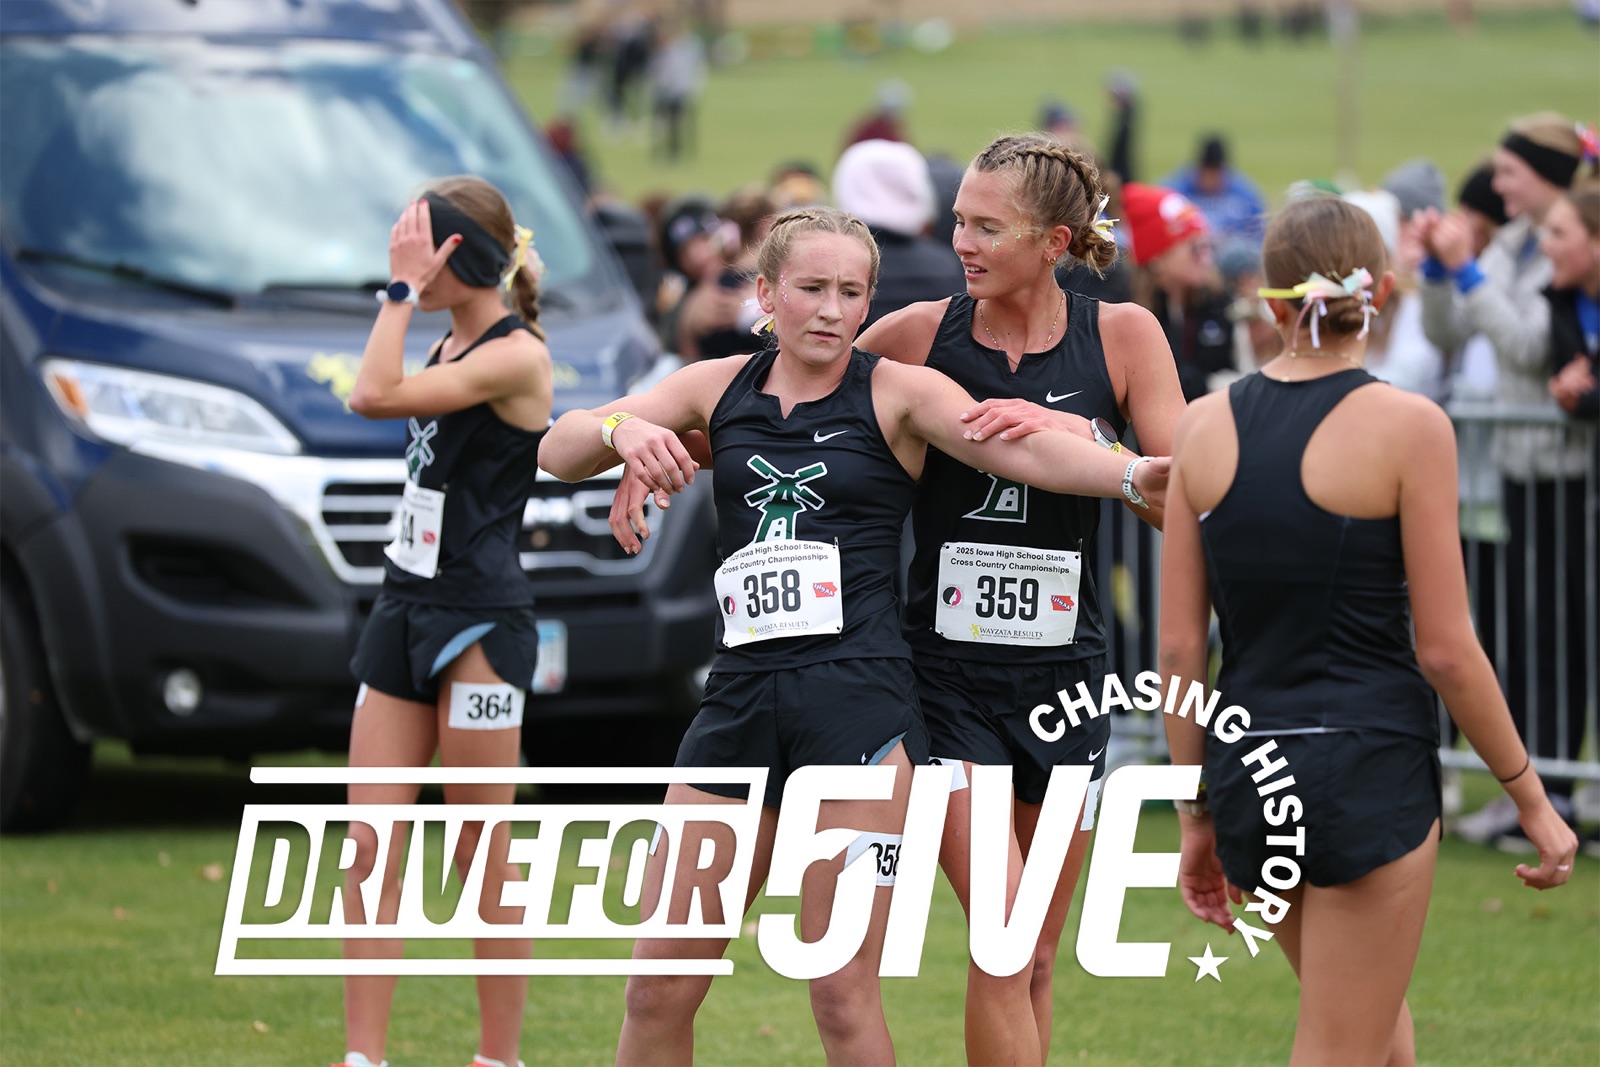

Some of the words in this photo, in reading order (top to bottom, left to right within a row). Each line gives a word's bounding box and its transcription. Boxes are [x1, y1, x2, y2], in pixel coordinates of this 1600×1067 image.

[740, 550, 754, 559] Iowa
[755, 544, 772, 555] High
[774, 543, 802, 552] School
[803, 543, 824, 551] State
[956, 546, 975, 555] 2025
[976, 548, 995, 557] Iowa
[996, 550, 1015, 560] High
[1016, 551, 1044, 561] School
[1045, 553, 1066, 562] State
[721, 565, 739, 575] Cross
[739, 559, 766, 571] Country
[767, 552, 829, 564] Championships
[950, 557, 974, 567] Cross
[975, 559, 1007, 570] Country
[1008, 561, 1070, 575] Championships
[743, 569, 802, 619] 358
[975, 575, 1040, 622] 359
[754, 623, 778, 635] WAYZATA
[779, 620, 809, 628] RESULTS
[979, 627, 1012, 636] WAYZATA
[1013, 630, 1044, 639] RESULTS
[467, 692, 512, 721] 364
